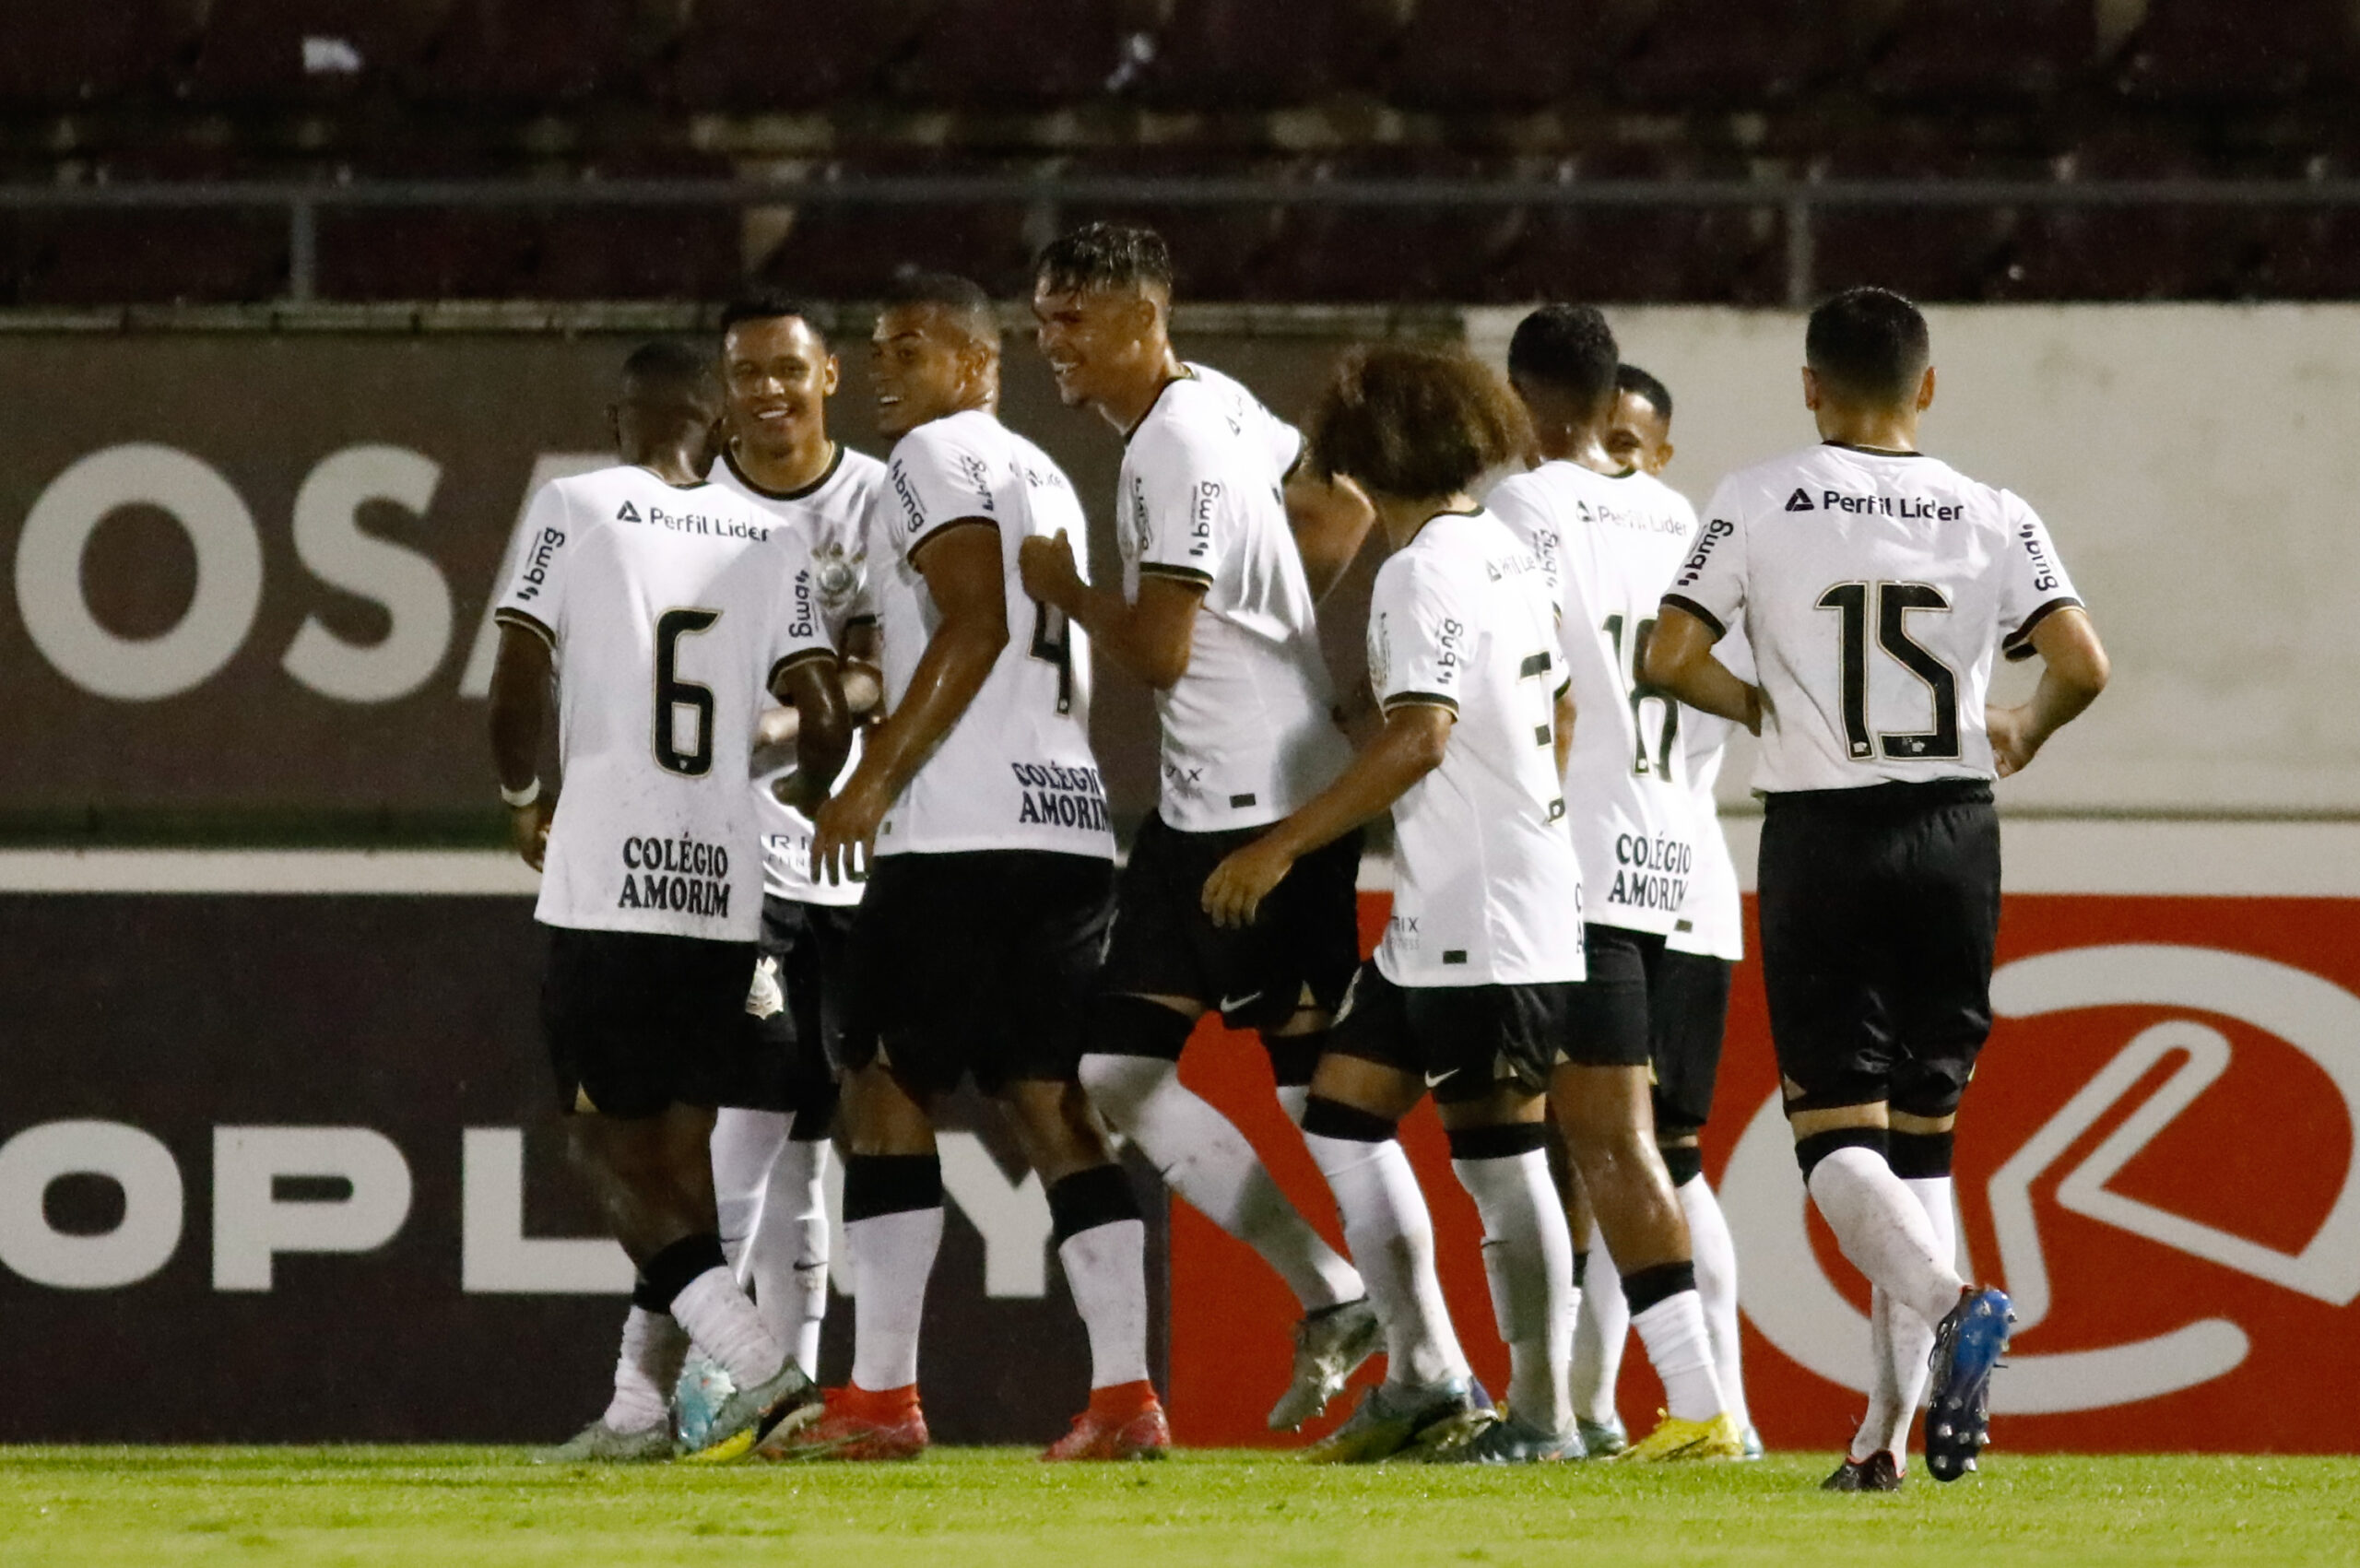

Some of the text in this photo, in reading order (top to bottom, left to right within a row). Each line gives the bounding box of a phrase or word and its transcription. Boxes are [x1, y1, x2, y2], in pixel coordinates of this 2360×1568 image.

[649, 507, 771, 543] Perfil Líder
[894, 472, 926, 534] bmg
[1191, 480, 1221, 539] bmg
[1823, 489, 1965, 522] Perfil Líder
[522, 526, 565, 586] bmg
[1684, 518, 1735, 571] bmg
[2024, 540, 2059, 592] bmg
[15, 442, 622, 703] OS
[788, 584, 813, 638] bmg
[654, 606, 723, 778] 6
[1815, 580, 1963, 761] 15
[622, 831, 729, 879] COLÉGIO
[1615, 831, 1692, 875] COLÉGIO
[617, 874, 731, 919] AMORIM
[0, 1119, 1125, 1298] OPLY
